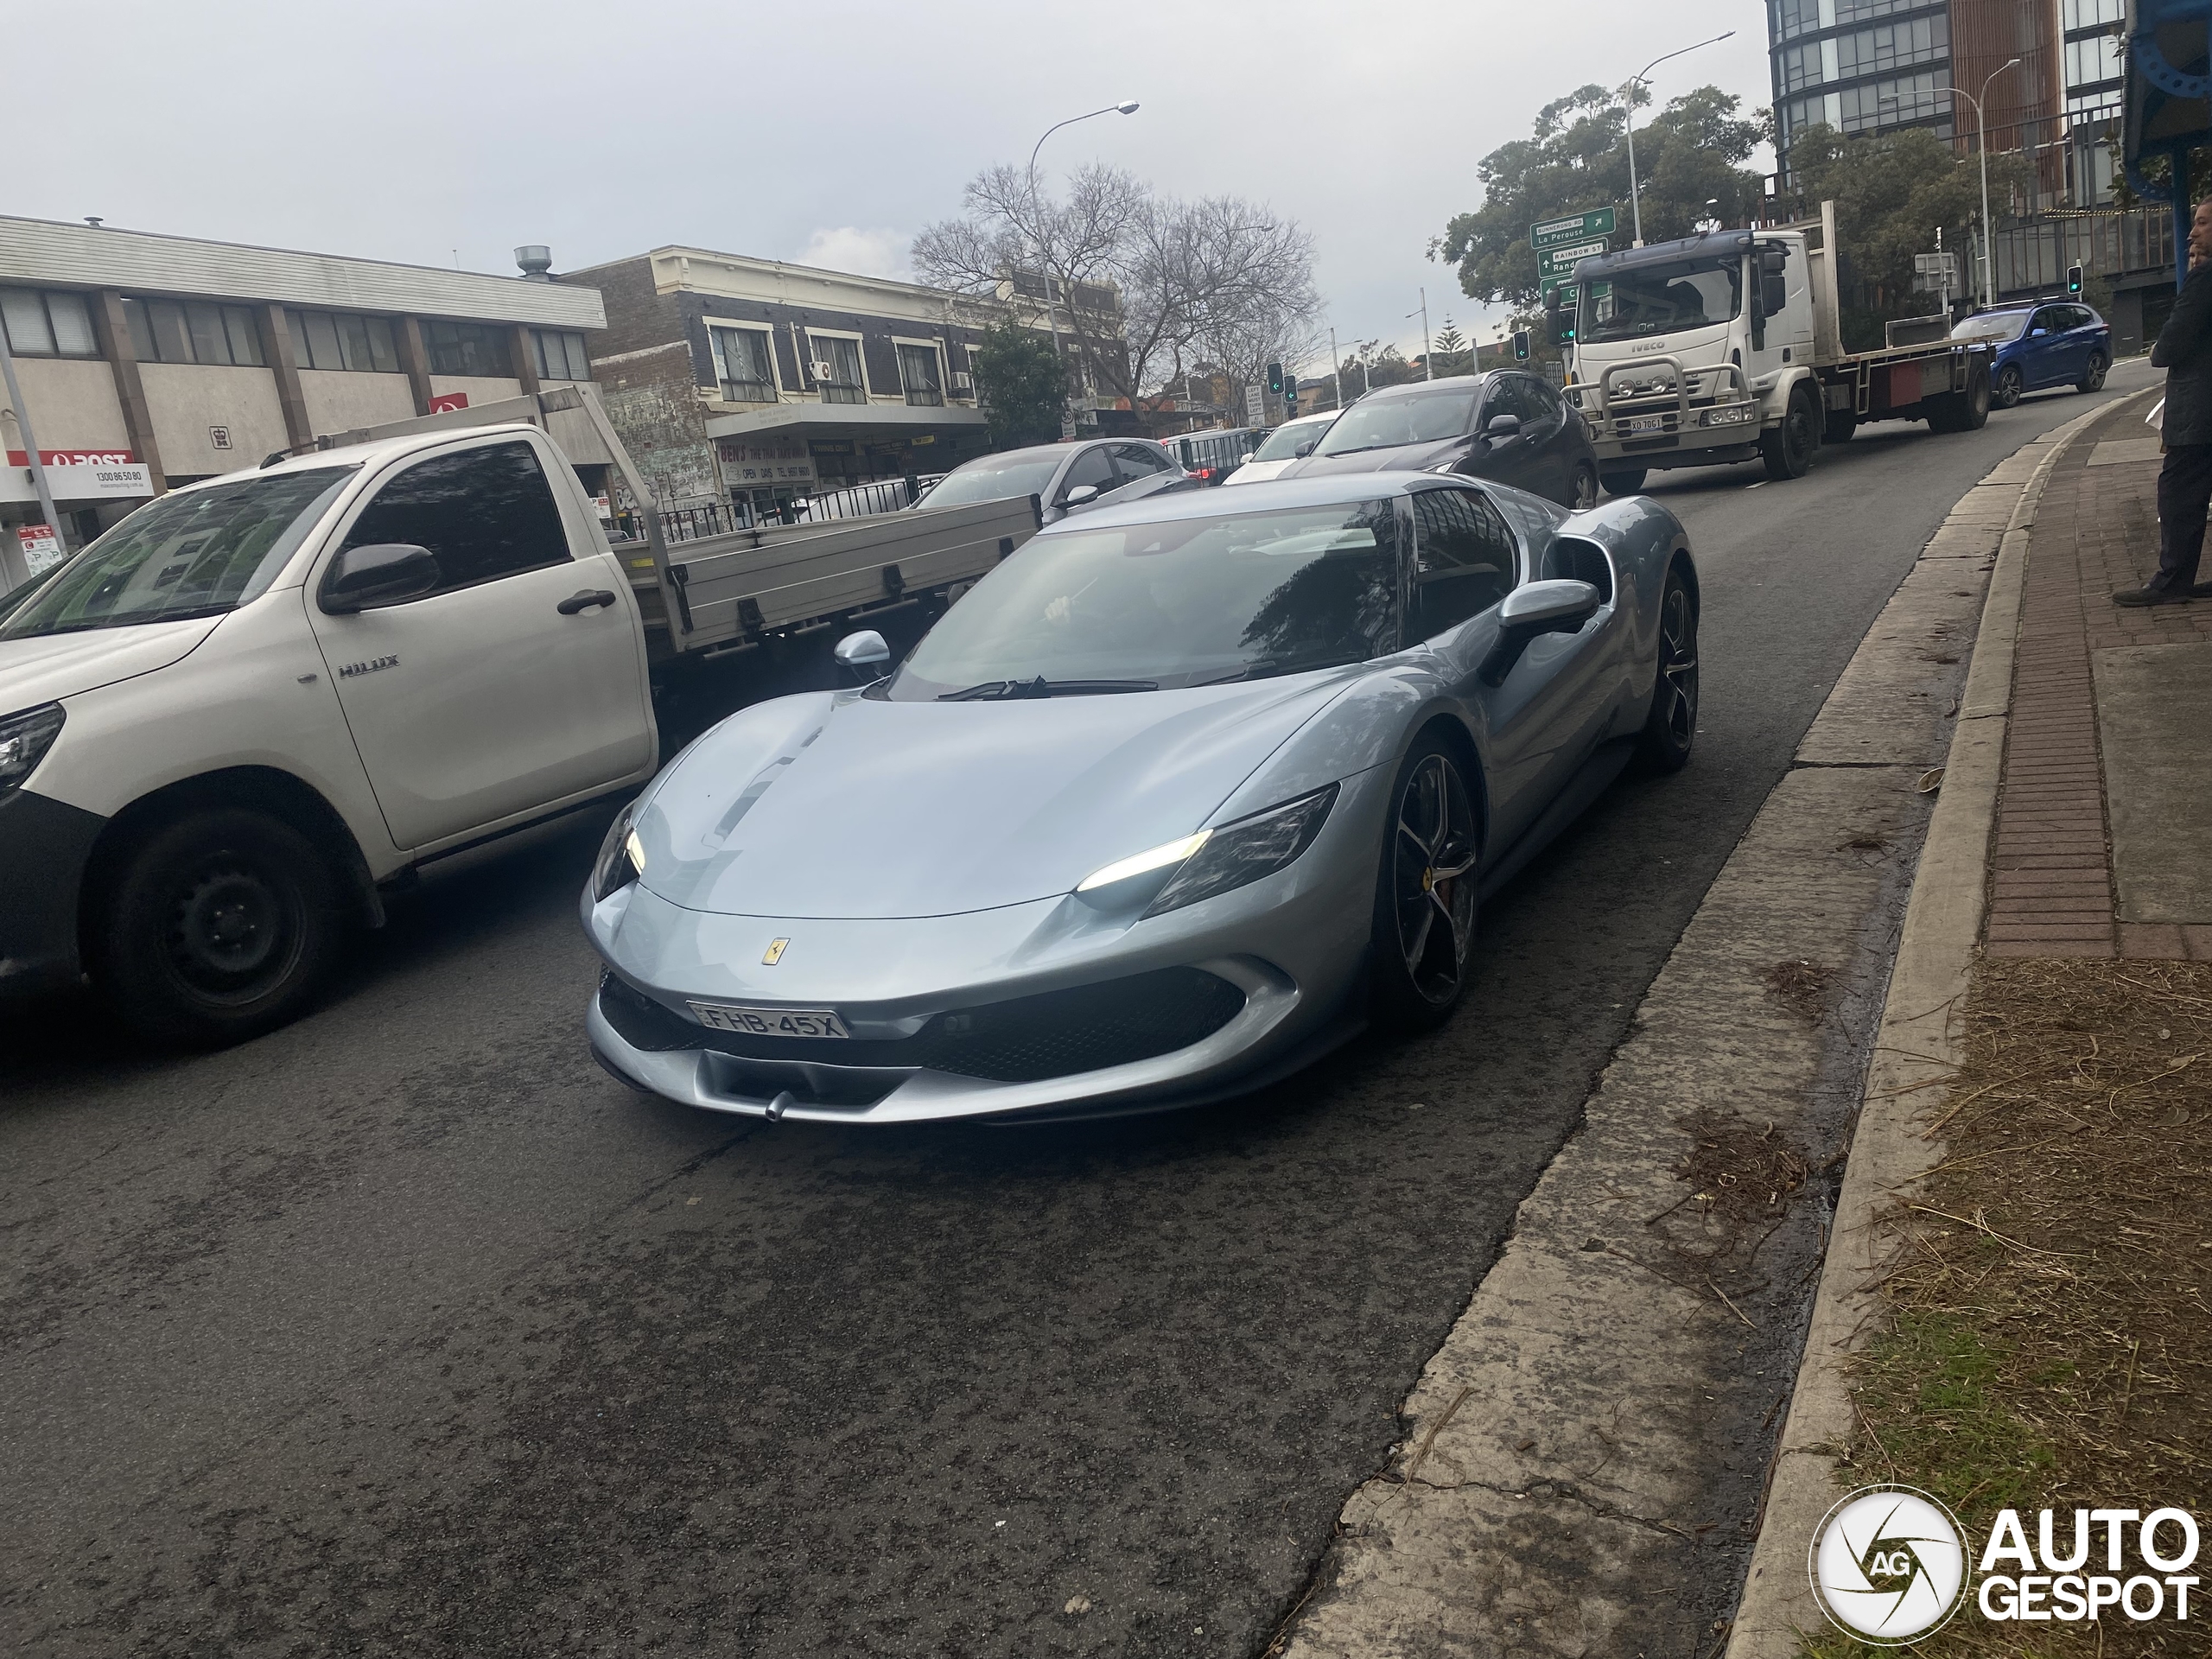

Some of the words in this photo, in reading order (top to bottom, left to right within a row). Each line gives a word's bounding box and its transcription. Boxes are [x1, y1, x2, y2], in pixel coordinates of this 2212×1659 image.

[1552, 229, 1584, 241] Perouse
[1554, 248, 1589, 260] RAINBOW
[1554, 261, 1576, 272] Rand
[1631, 341, 1665, 353] IVECO
[720, 444, 746, 463] BEN'S
[750, 448, 760, 460] THE
[813, 444, 835, 453] TWINS
[97, 472, 113, 481] 1300
[743, 468, 757, 479] OPEN
[339, 653, 400, 679] HILUX
